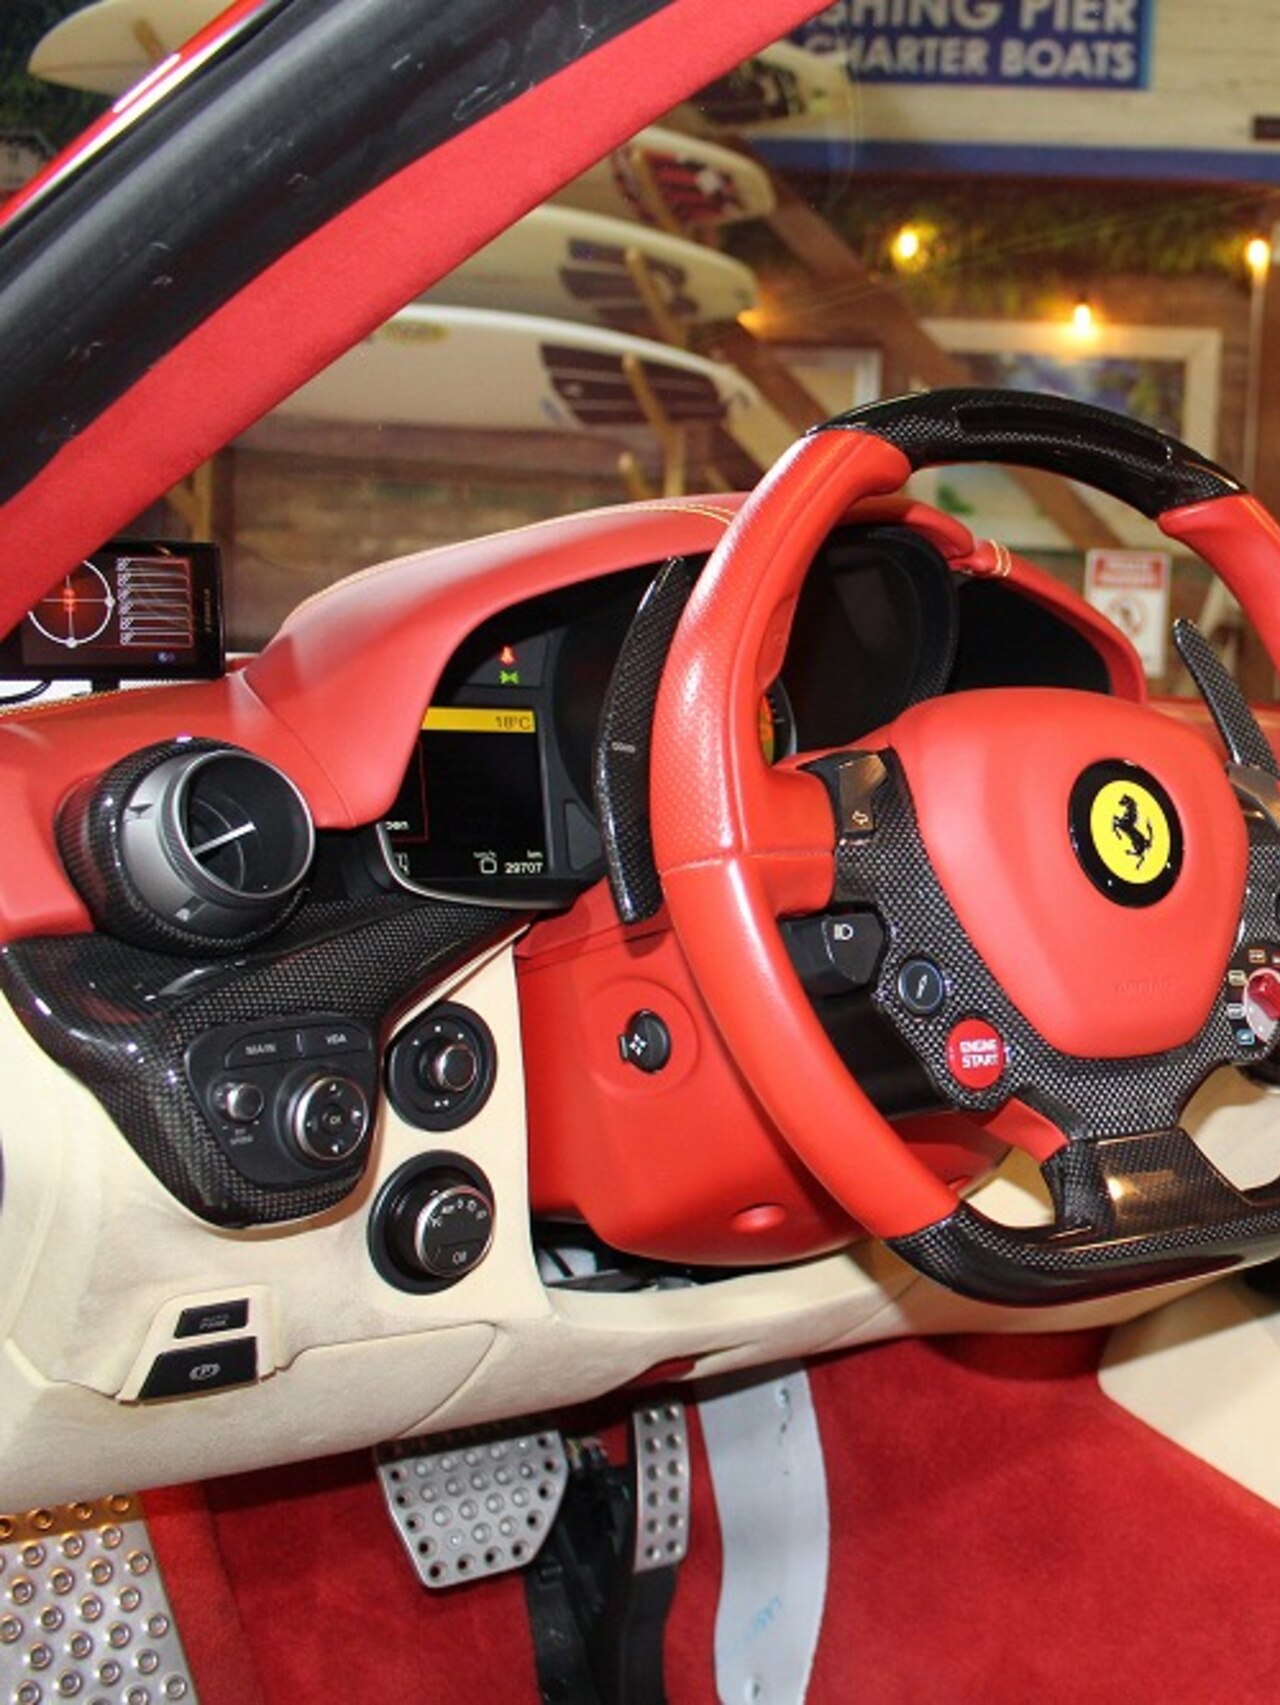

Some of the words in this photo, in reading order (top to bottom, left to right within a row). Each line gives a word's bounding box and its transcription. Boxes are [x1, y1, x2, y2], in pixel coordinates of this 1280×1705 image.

[1018, 0, 1137, 32] PIER
[1000, 37, 1136, 81] BOATS
[504, 862, 543, 875] 29707
[245, 1043, 276, 1055] MAIN
[960, 1039, 997, 1053] ENGINE
[962, 1053, 999, 1068] START
